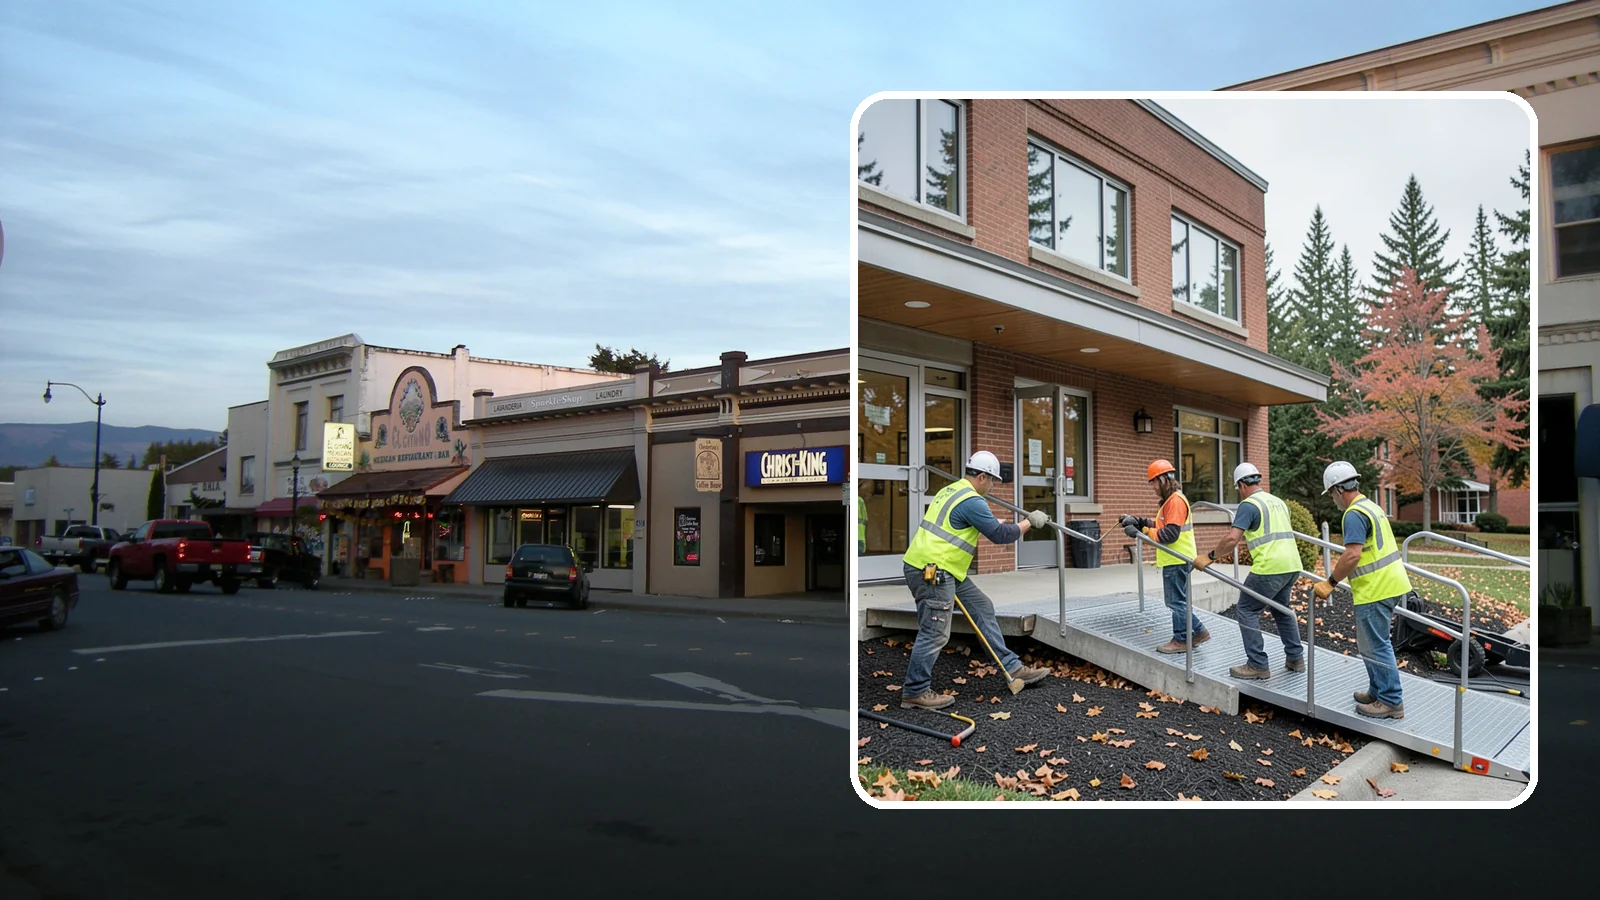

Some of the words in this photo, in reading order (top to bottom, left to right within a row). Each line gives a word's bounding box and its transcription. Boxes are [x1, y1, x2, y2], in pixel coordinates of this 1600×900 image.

[530, 396, 561, 409] Sparkle
[562, 394, 582, 404] Shop
[595, 389, 624, 400] LAUNDRY
[493, 402, 523, 413] LAVANDERIA
[373, 454, 396, 464] MEXICAN
[398, 451, 434, 462] RESTAURANT
[437, 450, 450, 459] BAR
[760, 452, 797, 478] CHRIST
[799, 450, 827, 476] KING
